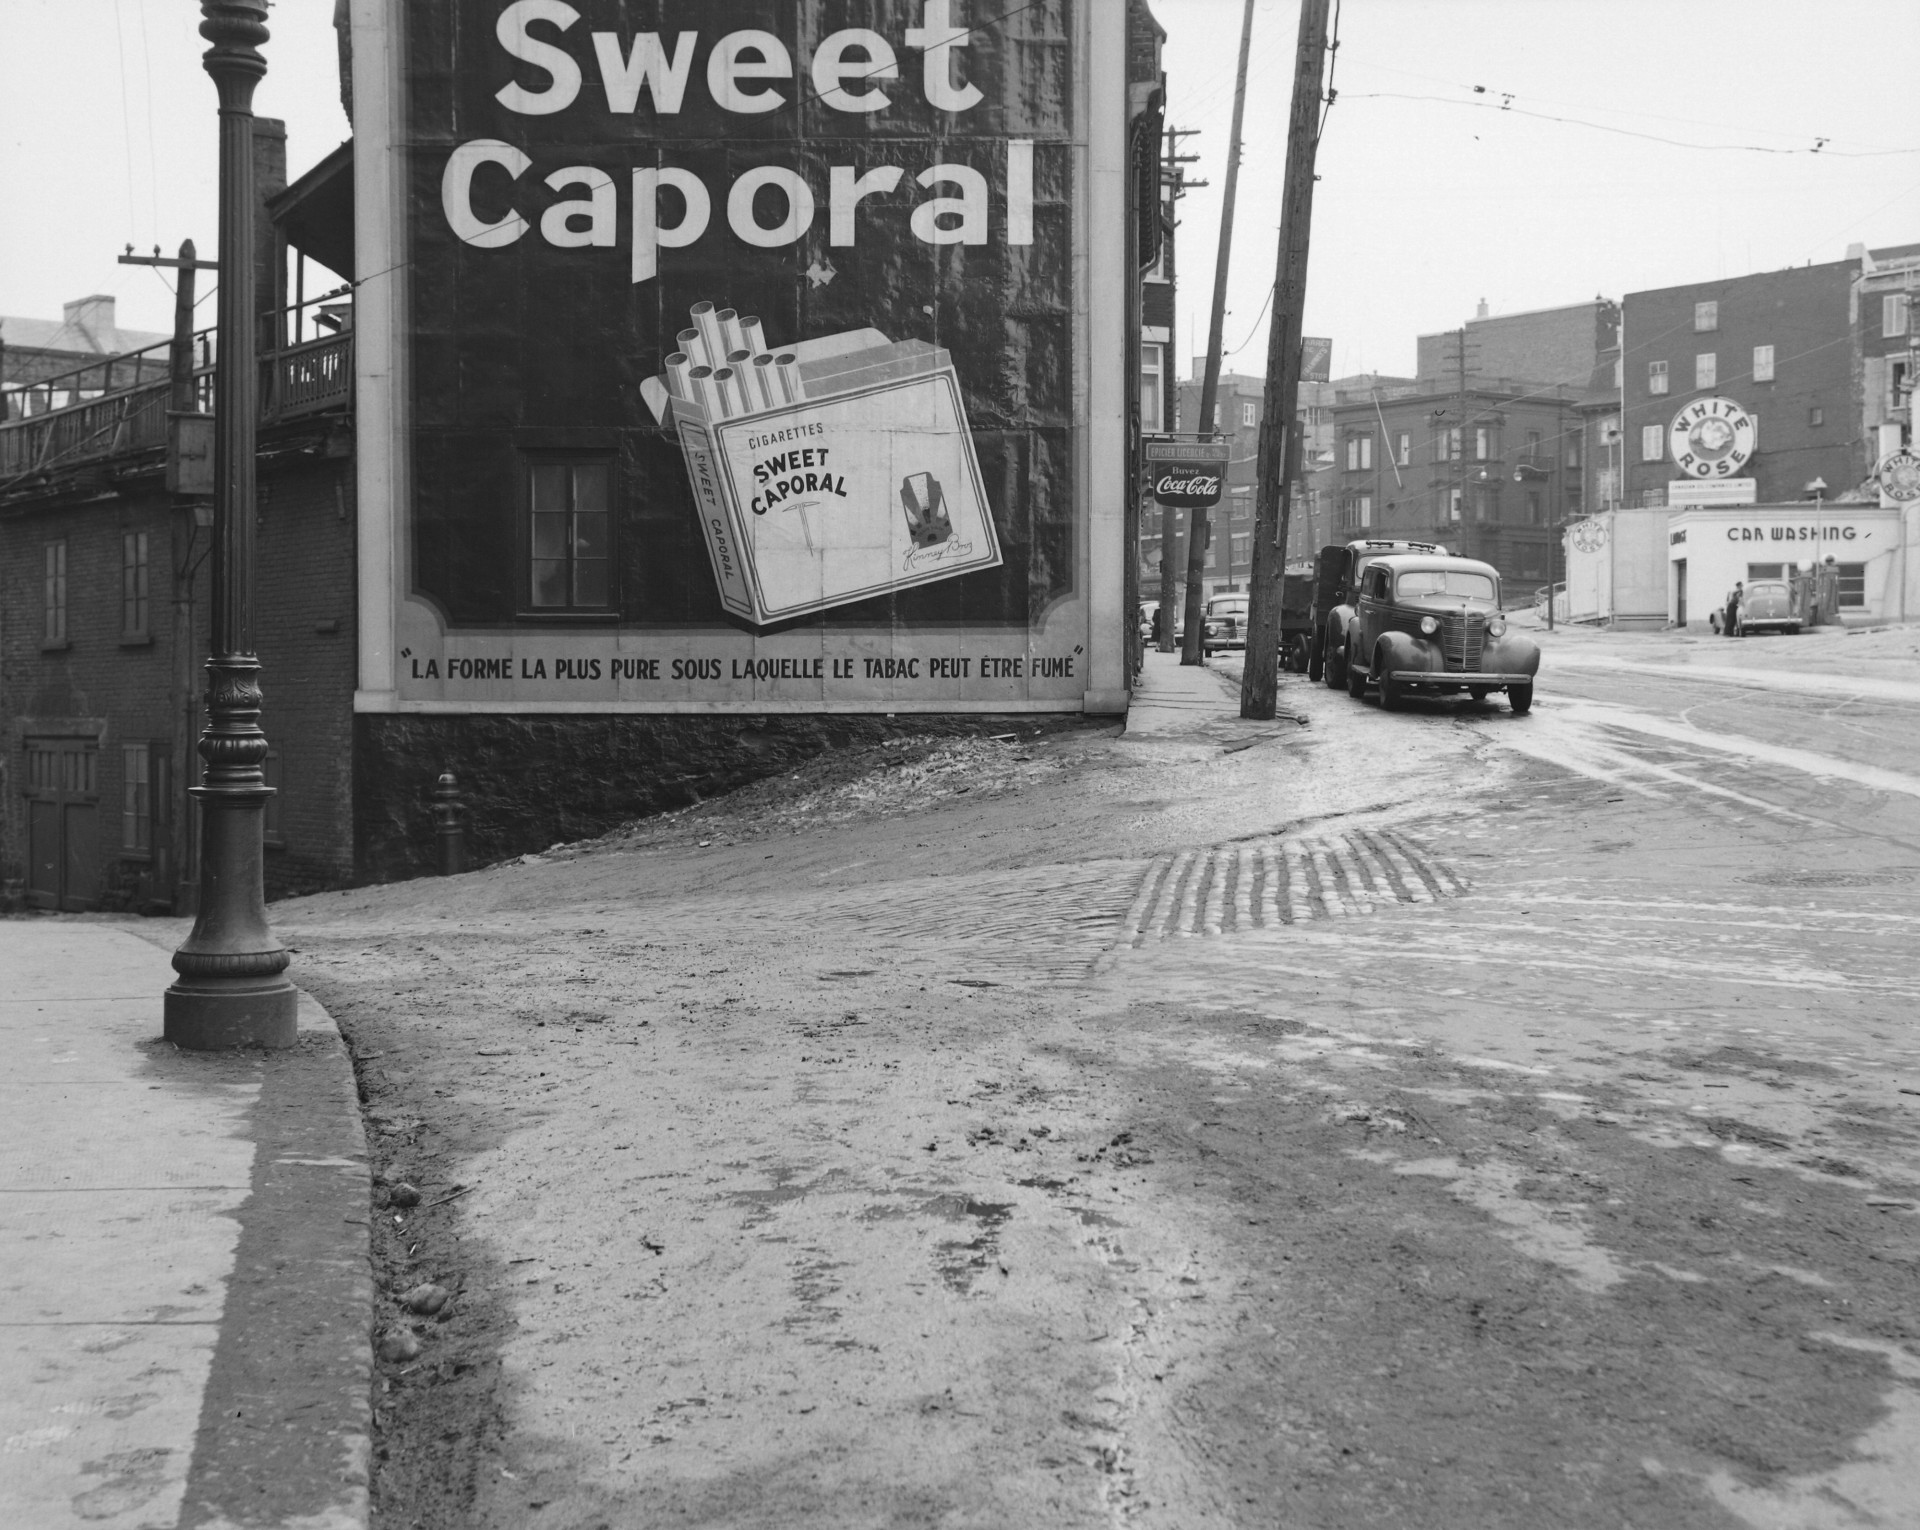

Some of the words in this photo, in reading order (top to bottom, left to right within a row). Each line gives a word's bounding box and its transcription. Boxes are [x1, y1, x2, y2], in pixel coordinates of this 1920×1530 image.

[494, 0, 985, 116] Sweet
[441, 138, 1035, 284] Caporal
[1674, 401, 1750, 433] WHITE
[748, 422, 824, 451] CIGARETTES
[753, 448, 829, 484] SWEET
[1172, 466, 1201, 475] Buvez
[1679, 449, 1747, 476] ROSE
[694, 452, 717, 507] SWEET
[750, 472, 848, 516] CAPORAL
[1156, 475, 1221, 496] Coca-Cola
[711, 518, 734, 581] CAPORAL
[1727, 526, 1764, 542] CAR
[1770, 525, 1857, 542] WASHING
[447, 658, 513, 680] FORME
[521, 658, 547, 680] LA
[555, 658, 602, 680] PLUS
[611, 658, 660, 680] PURE
[671, 658, 722, 680] SOUS
[732, 658, 824, 681] LAQUELLE
[833, 658, 854, 679] LE
[863, 657, 920, 679] TABAC
[929, 657, 971, 679] PEUT
